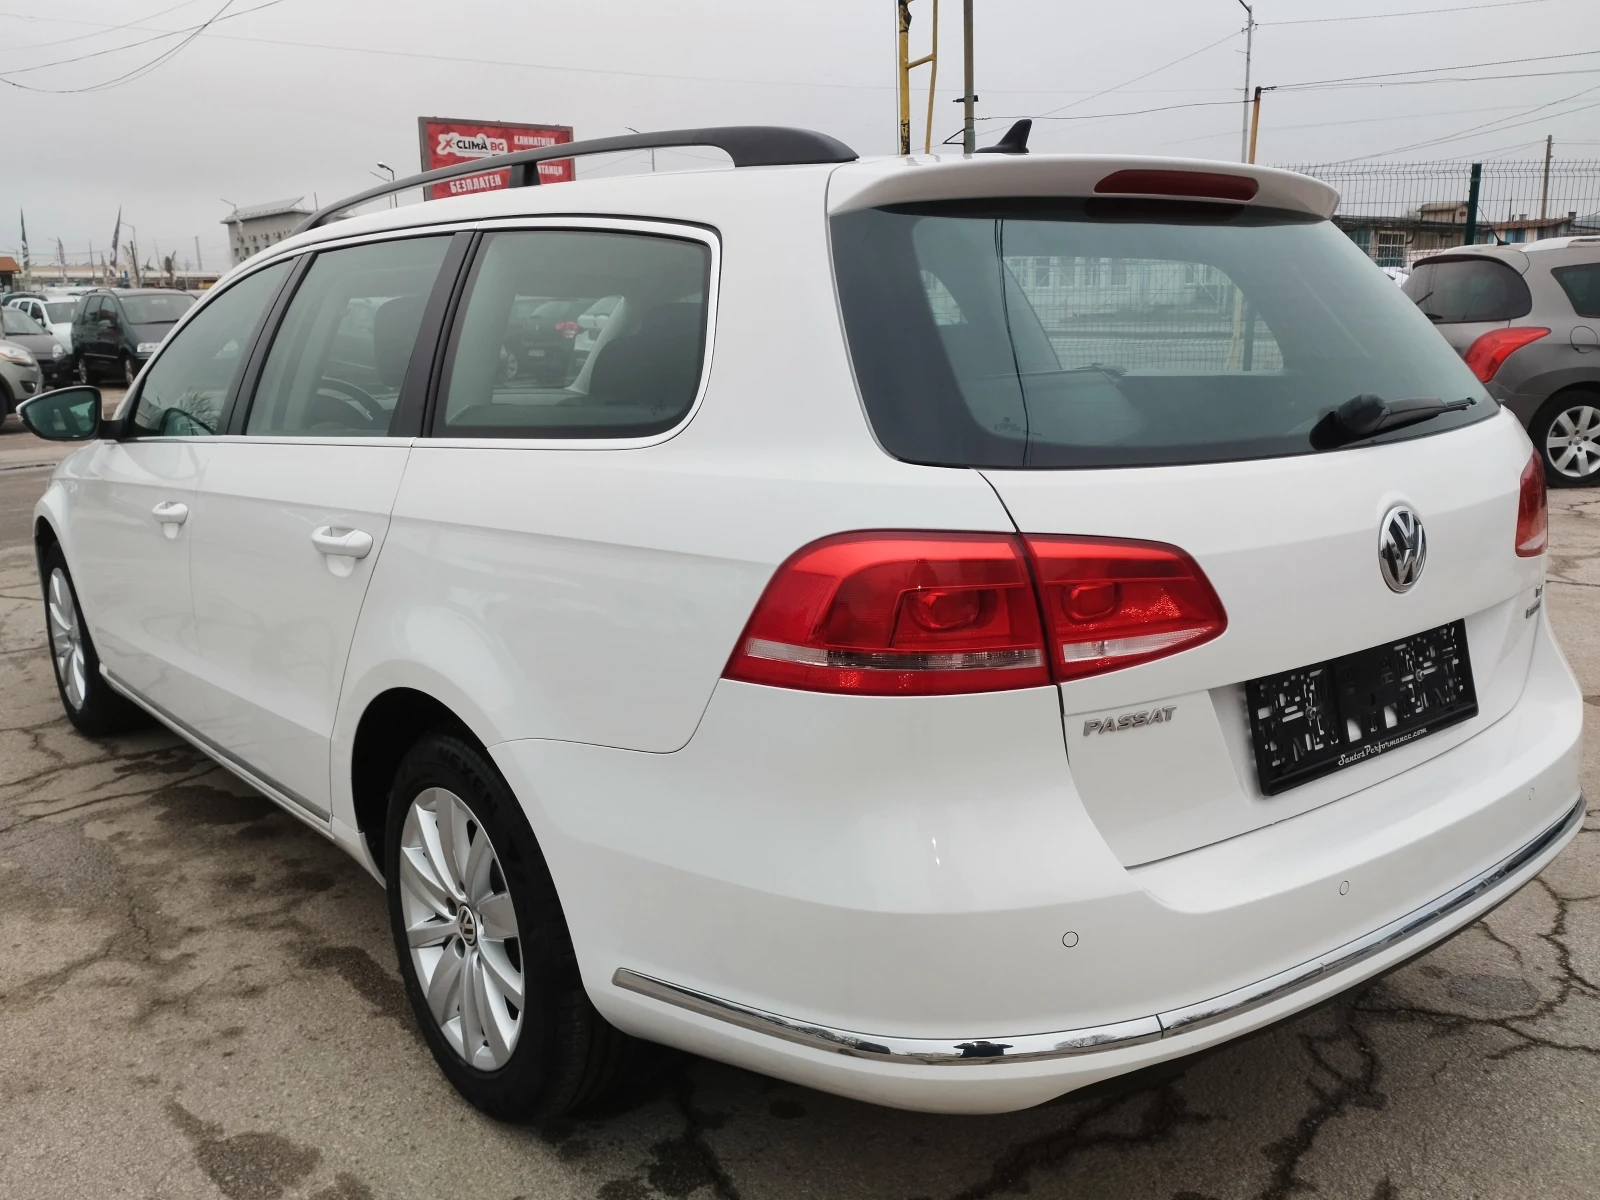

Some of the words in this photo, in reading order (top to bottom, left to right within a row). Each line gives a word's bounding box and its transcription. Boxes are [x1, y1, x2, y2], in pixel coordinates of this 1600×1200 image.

[450, 174, 502, 194] БЕЗПЛАТЕН
[1083, 705, 1177, 736] PASSAT
[1337, 727, 1428, 766] SantosPerformance.com
